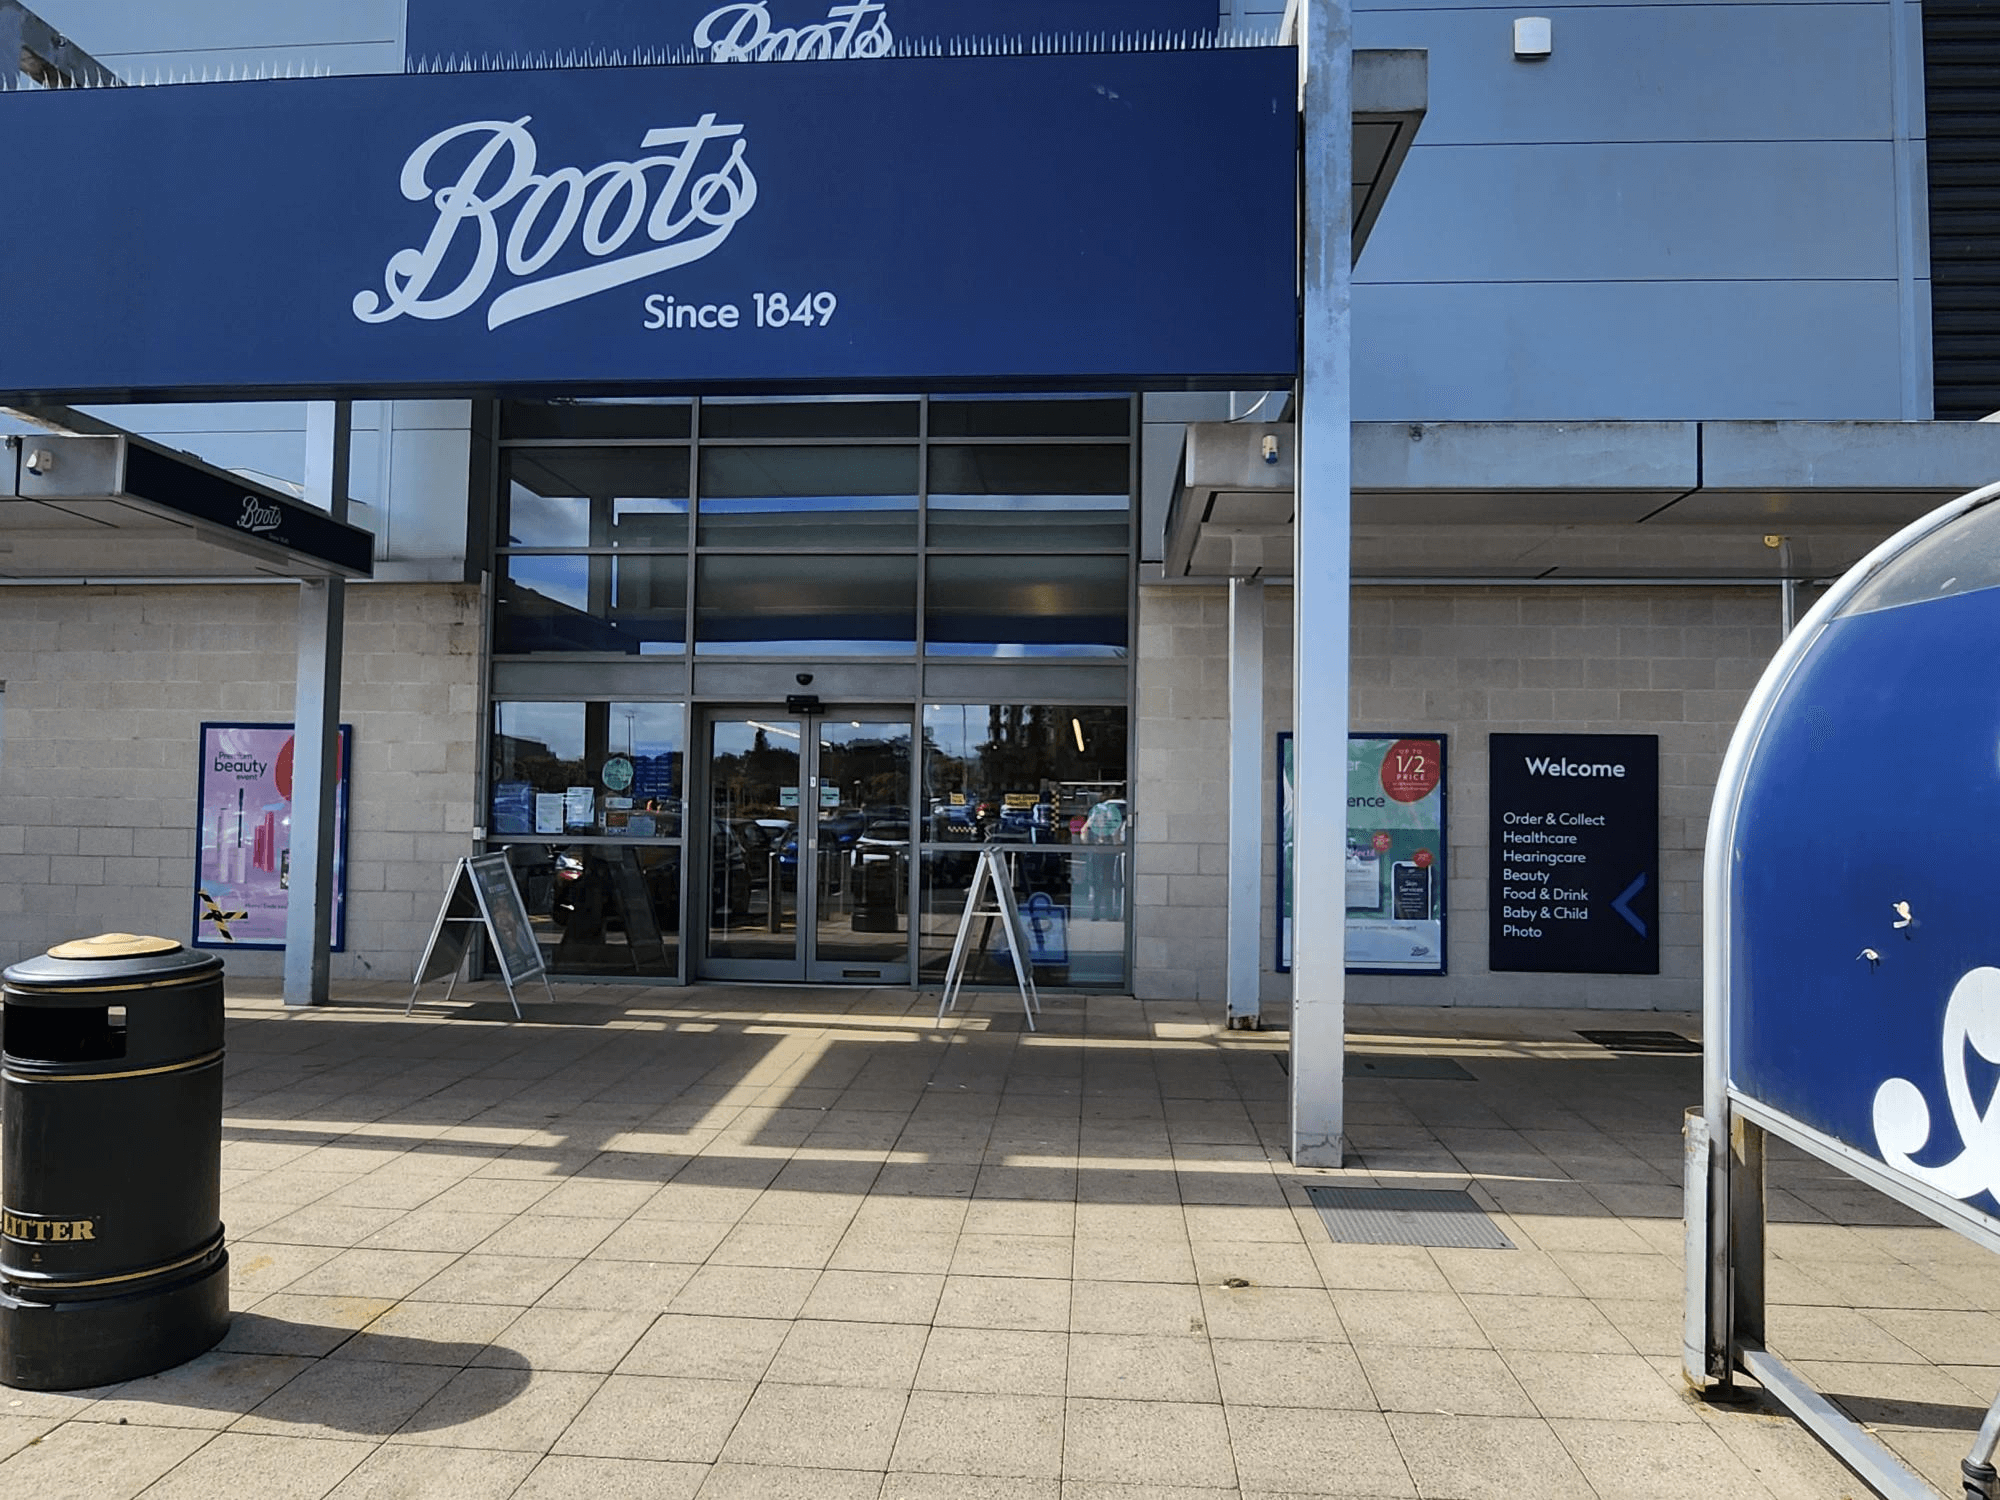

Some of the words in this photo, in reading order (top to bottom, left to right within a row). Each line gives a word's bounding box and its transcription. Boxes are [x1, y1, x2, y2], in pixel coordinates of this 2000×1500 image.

[352, 112, 758, 331] Boots
[643, 294, 740, 329] Since
[753, 291, 837, 328] 1849
[236, 495, 282, 532] Boots
[213, 756, 268, 777] beauty
[1395, 755, 1425, 773] 1/2
[1524, 757, 1626, 778] Welcome
[236, 773, 258, 781] event
[1396, 773, 1425, 781] PRICE
[1503, 811, 1544, 825] Order
[1545, 812, 1557, 825] &
[1559, 812, 1606, 826] Collect
[1503, 830, 1578, 844] Healthcare
[1503, 849, 1587, 866] Hearingcare
[1503, 868, 1550, 885] Beauty
[1503, 886, 1536, 900] Food
[1539, 887, 1551, 900] &
[1553, 887, 1589, 901] Drink
[1503, 905, 1538, 922] Baby
[1540, 906, 1552, 919] &
[1553, 906, 1588, 920] Child
[1503, 924, 1543, 938] Photo
[3, 1211, 96, 1241] LITTER
